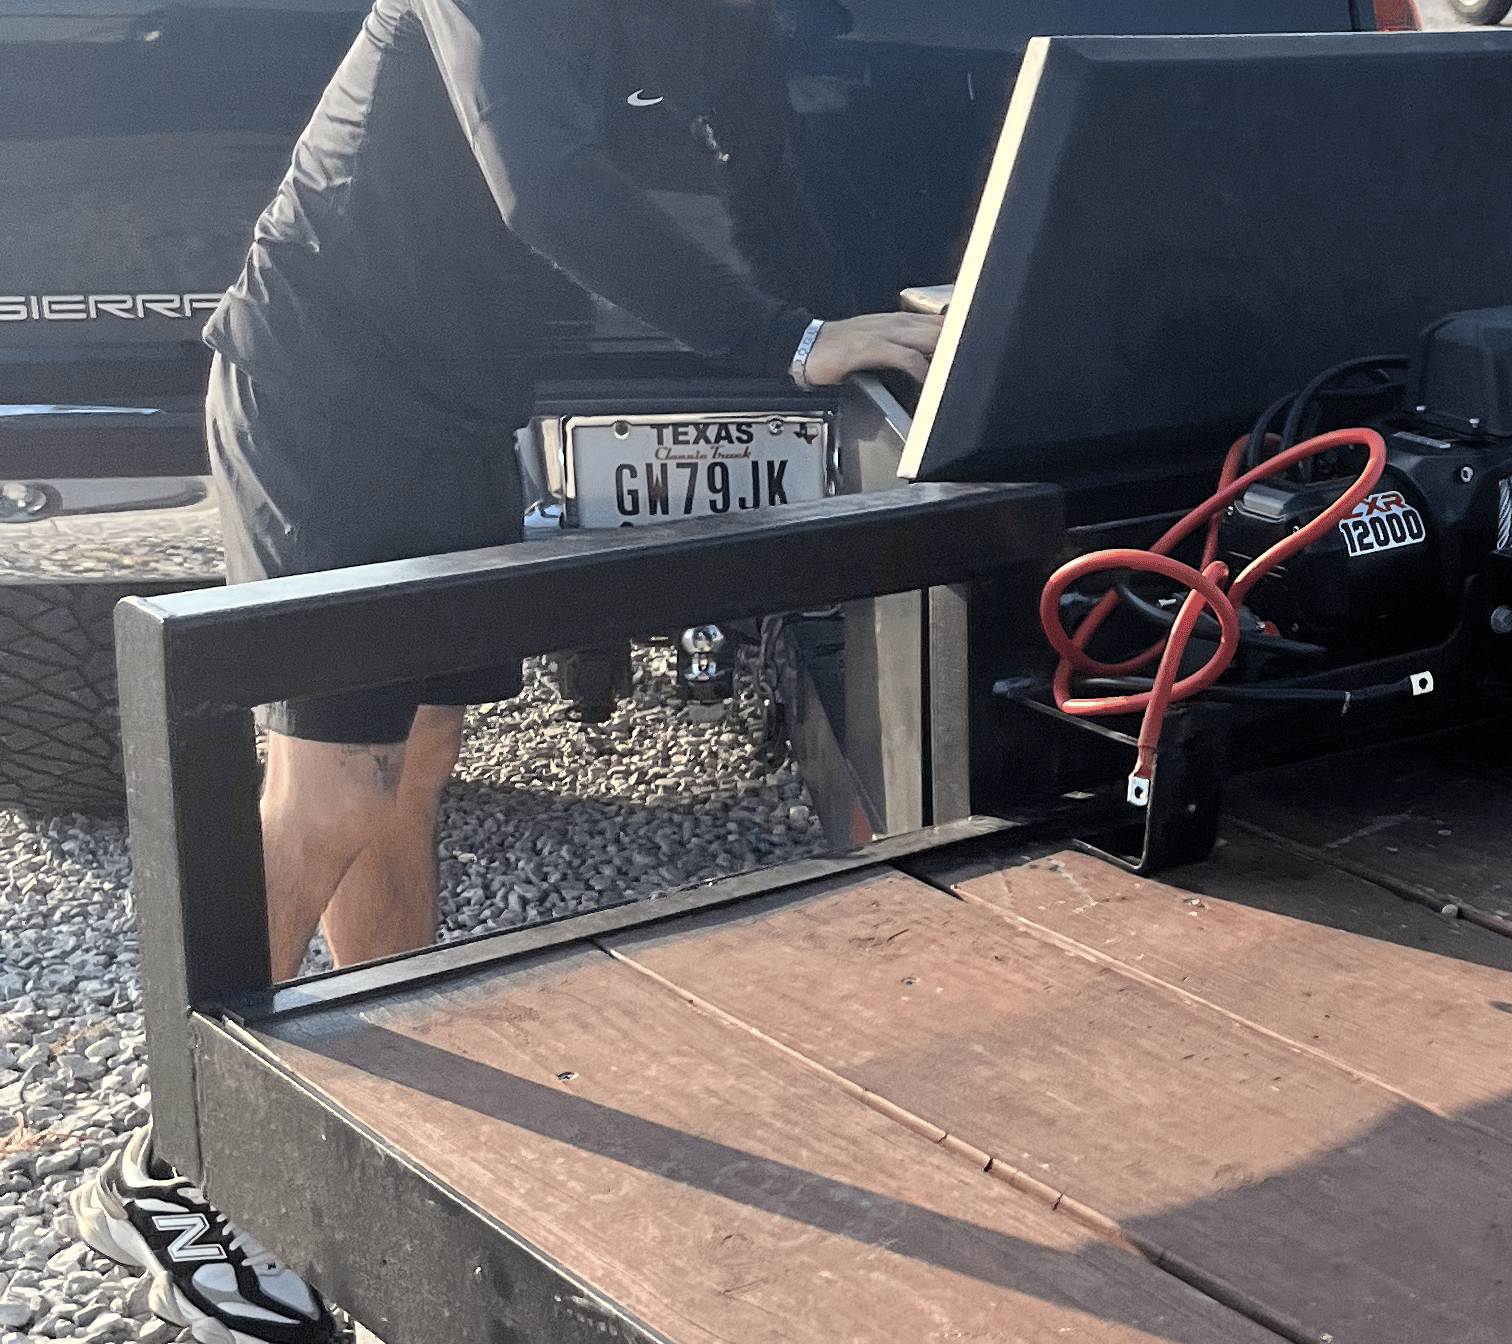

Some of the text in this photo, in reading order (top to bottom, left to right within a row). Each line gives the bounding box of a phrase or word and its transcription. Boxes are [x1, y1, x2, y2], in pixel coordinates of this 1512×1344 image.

[650, 422, 755, 445] TEXAS
[615, 459, 789, 516] GW79JK
[1340, 509, 1424, 553] 12000
